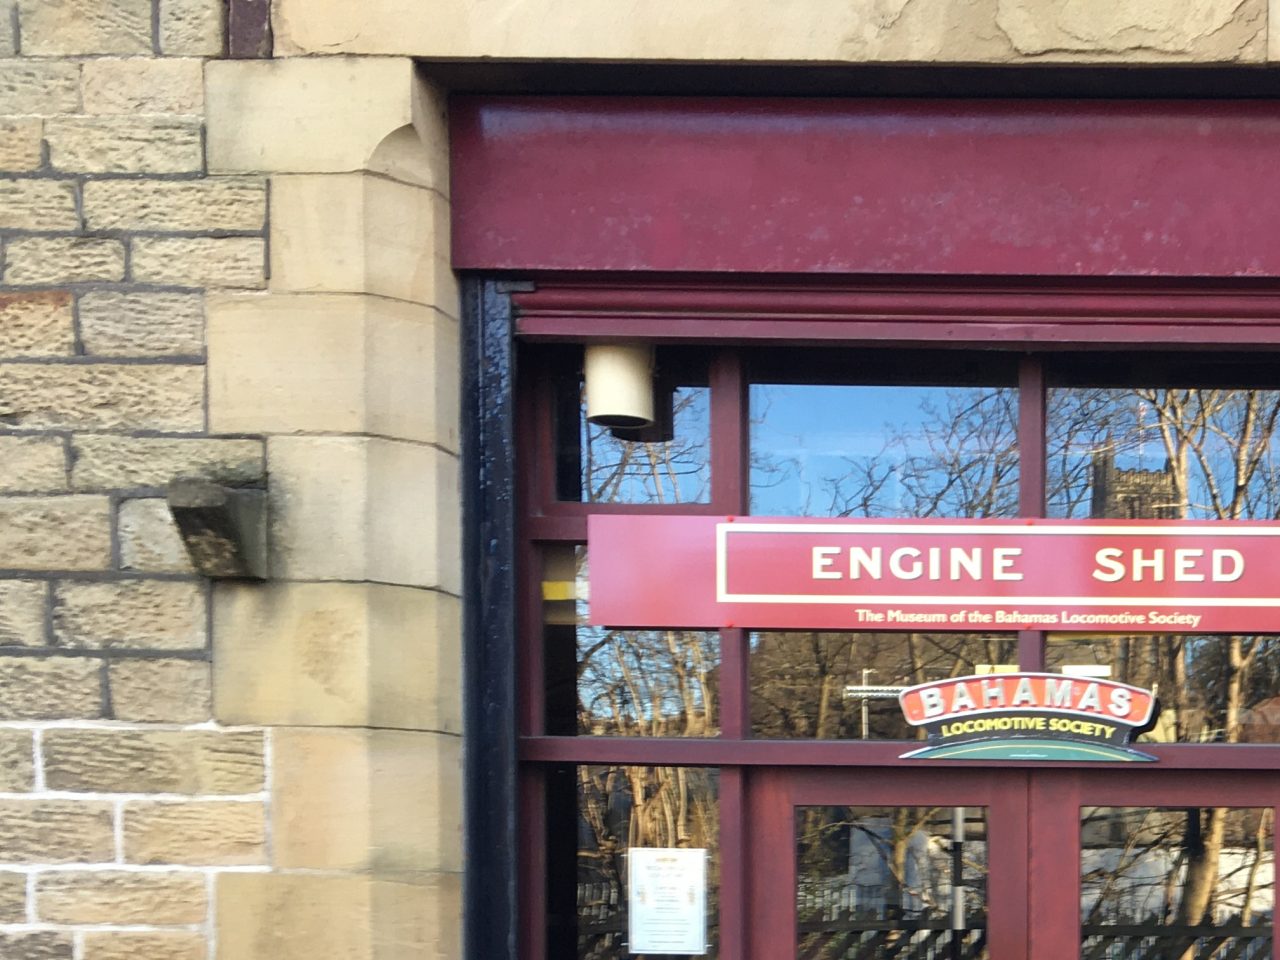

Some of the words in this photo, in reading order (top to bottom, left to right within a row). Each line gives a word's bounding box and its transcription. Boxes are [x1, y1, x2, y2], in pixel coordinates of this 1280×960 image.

[812, 545, 1024, 582] ENGINE
[1092, 547, 1246, 583] SHED
[856, 608, 885, 623] The
[888, 609, 947, 624] Museum
[950, 609, 966, 624] of
[968, 609, 992, 624] the
[995, 610, 1058, 625] Bahamas
[1061, 611, 1147, 625] Locomotive
[1149, 611, 1202, 628] Society
[919, 677, 1133, 718] BAHAMAS
[941, 717, 1048, 738] LOCOMOTIVE
[1049, 717, 1117, 739] SOCIETY
